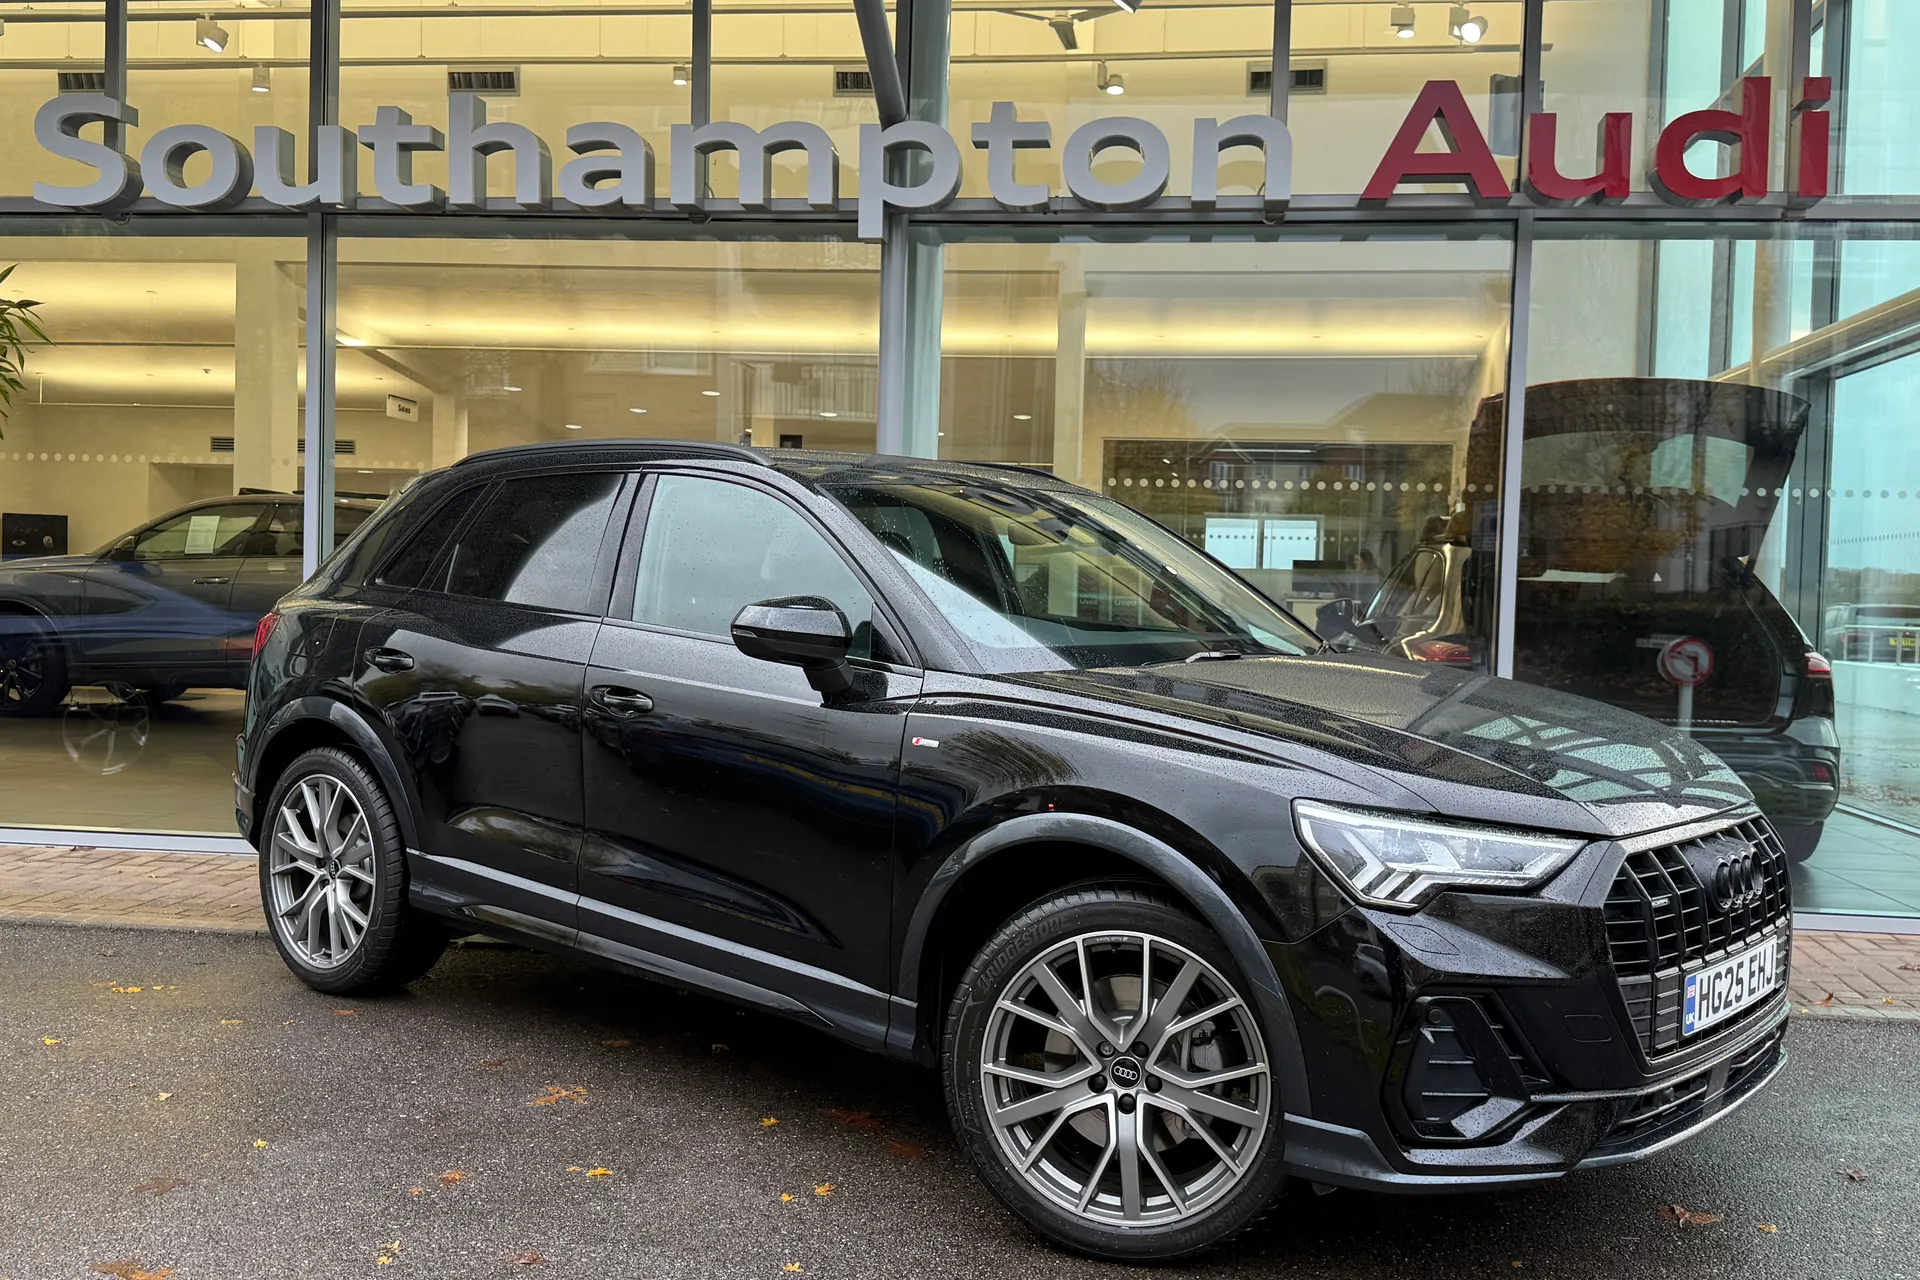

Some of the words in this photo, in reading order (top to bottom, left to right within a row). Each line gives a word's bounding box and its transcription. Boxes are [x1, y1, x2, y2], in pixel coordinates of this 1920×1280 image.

[33, 90, 1293, 243] Southampton
[1357, 76, 1831, 206] Audi
[398, 404, 411, 414] Sales
[1079, 598, 1099, 606] Used
[1698, 960, 1744, 1021] HG25
[1748, 944, 1775, 997] EHJ
[1686, 1012, 1695, 1024] UK
